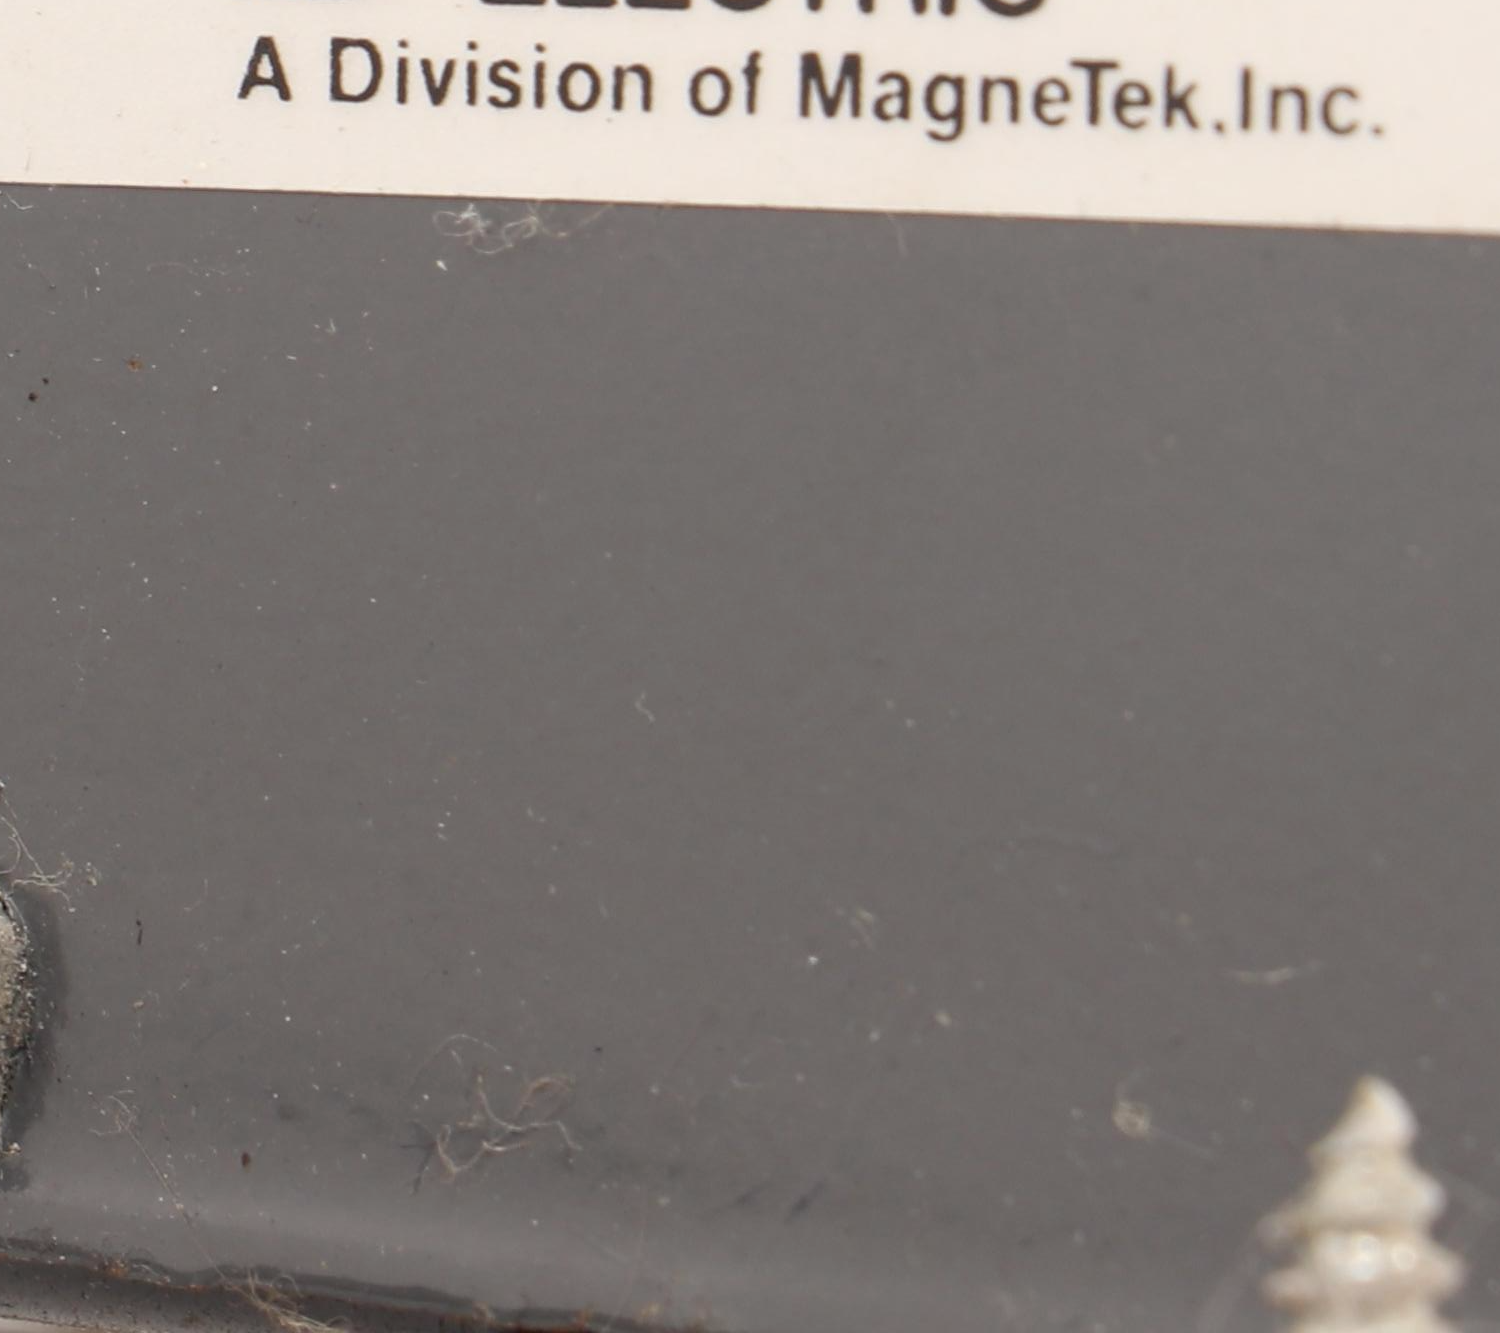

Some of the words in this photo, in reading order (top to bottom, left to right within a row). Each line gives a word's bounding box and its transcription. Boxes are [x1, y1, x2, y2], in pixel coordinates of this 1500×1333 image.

[236, 33, 294, 104] A
[328, 35, 654, 113] Division
[688, 51, 763, 117] of
